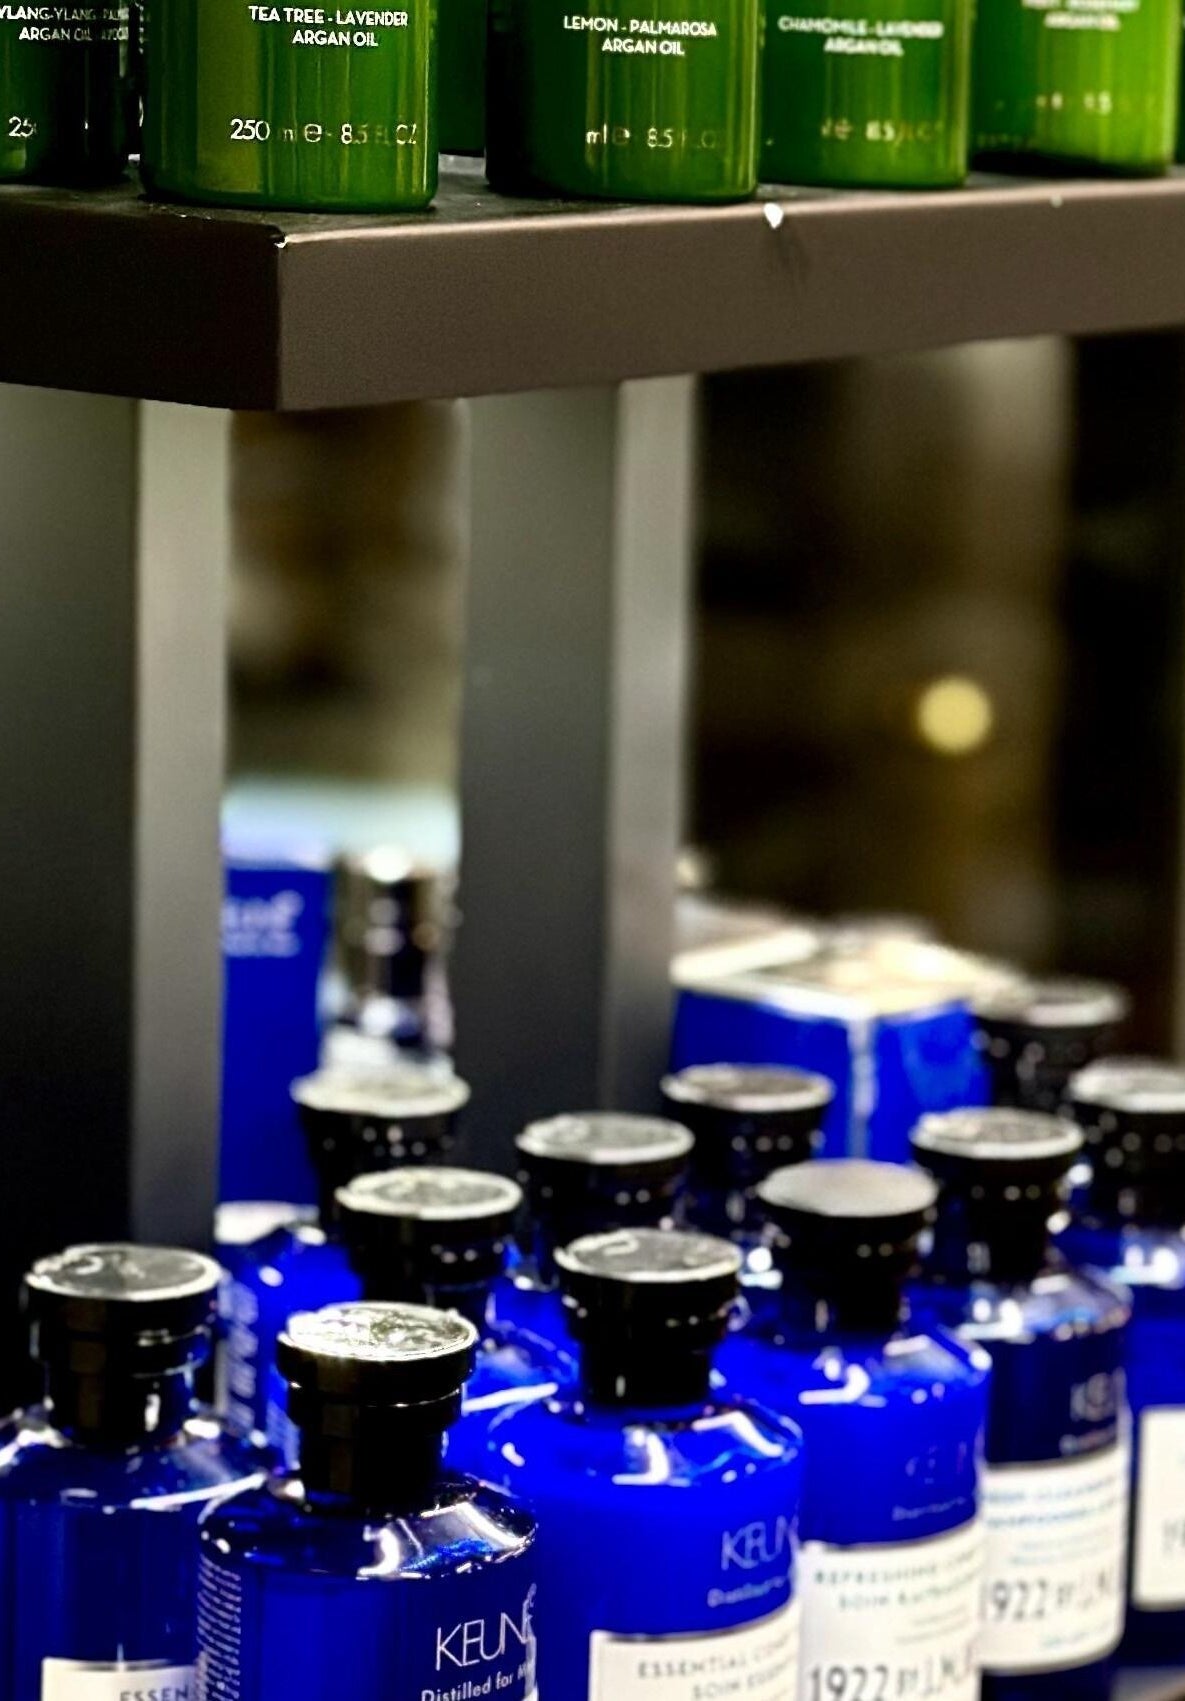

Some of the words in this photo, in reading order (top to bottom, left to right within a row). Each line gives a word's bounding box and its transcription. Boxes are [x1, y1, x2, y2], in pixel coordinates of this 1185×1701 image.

[248, 5, 280, 22] TEA
[283, 7, 325, 24] TREE
[336, 10, 409, 27] LAVENDER
[563, 15, 619, 32] LEMON
[629, 19, 717, 37] PALMAROSA
[19, 26, 71, 40] ARGAN
[292, 29, 350, 46] ARGAN
[353, 31, 379, 47] OIL
[601, 37, 657, 54] ARGAN
[659, 40, 686, 56] OIL
[230, 118, 270, 141] 250
[495, 1670, 514, 1691] for
[811, 1664, 888, 1701] 1922
